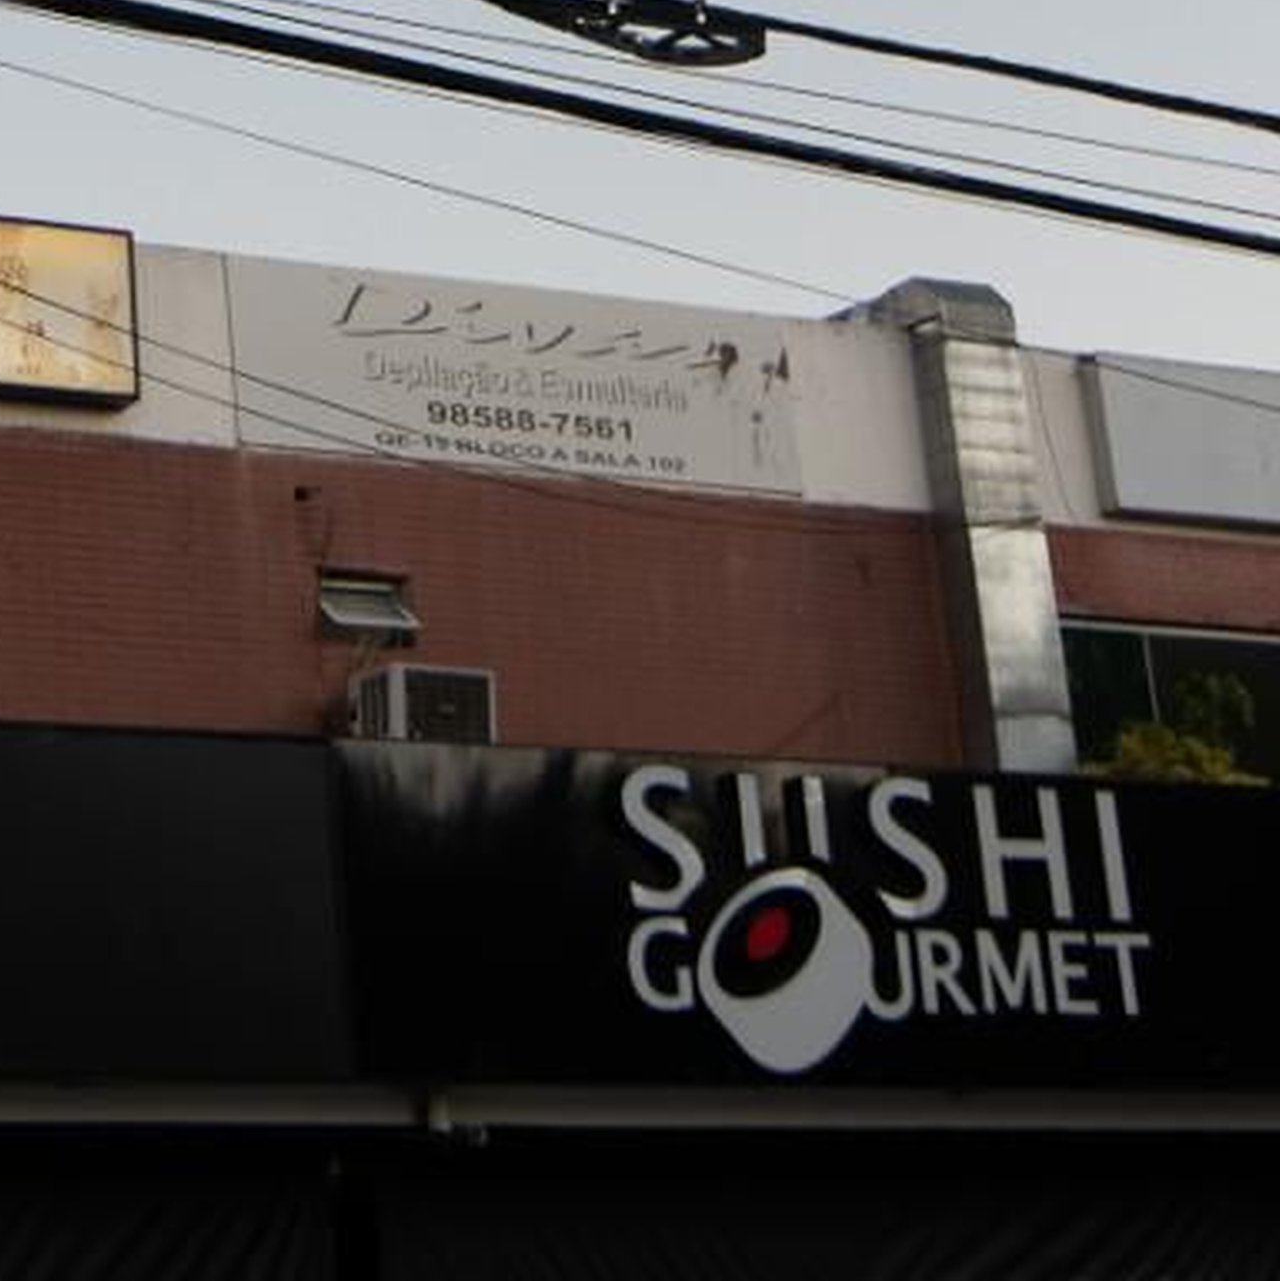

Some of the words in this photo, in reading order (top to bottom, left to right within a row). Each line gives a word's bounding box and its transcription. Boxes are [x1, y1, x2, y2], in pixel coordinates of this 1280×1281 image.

[427, 400, 632, 443] 98588-7561
[454, 436, 545, 460] BLOCO
[551, 447, 568, 461] A
[574, 450, 641, 468] SALA
[621, 765, 1133, 922] SUSHI
